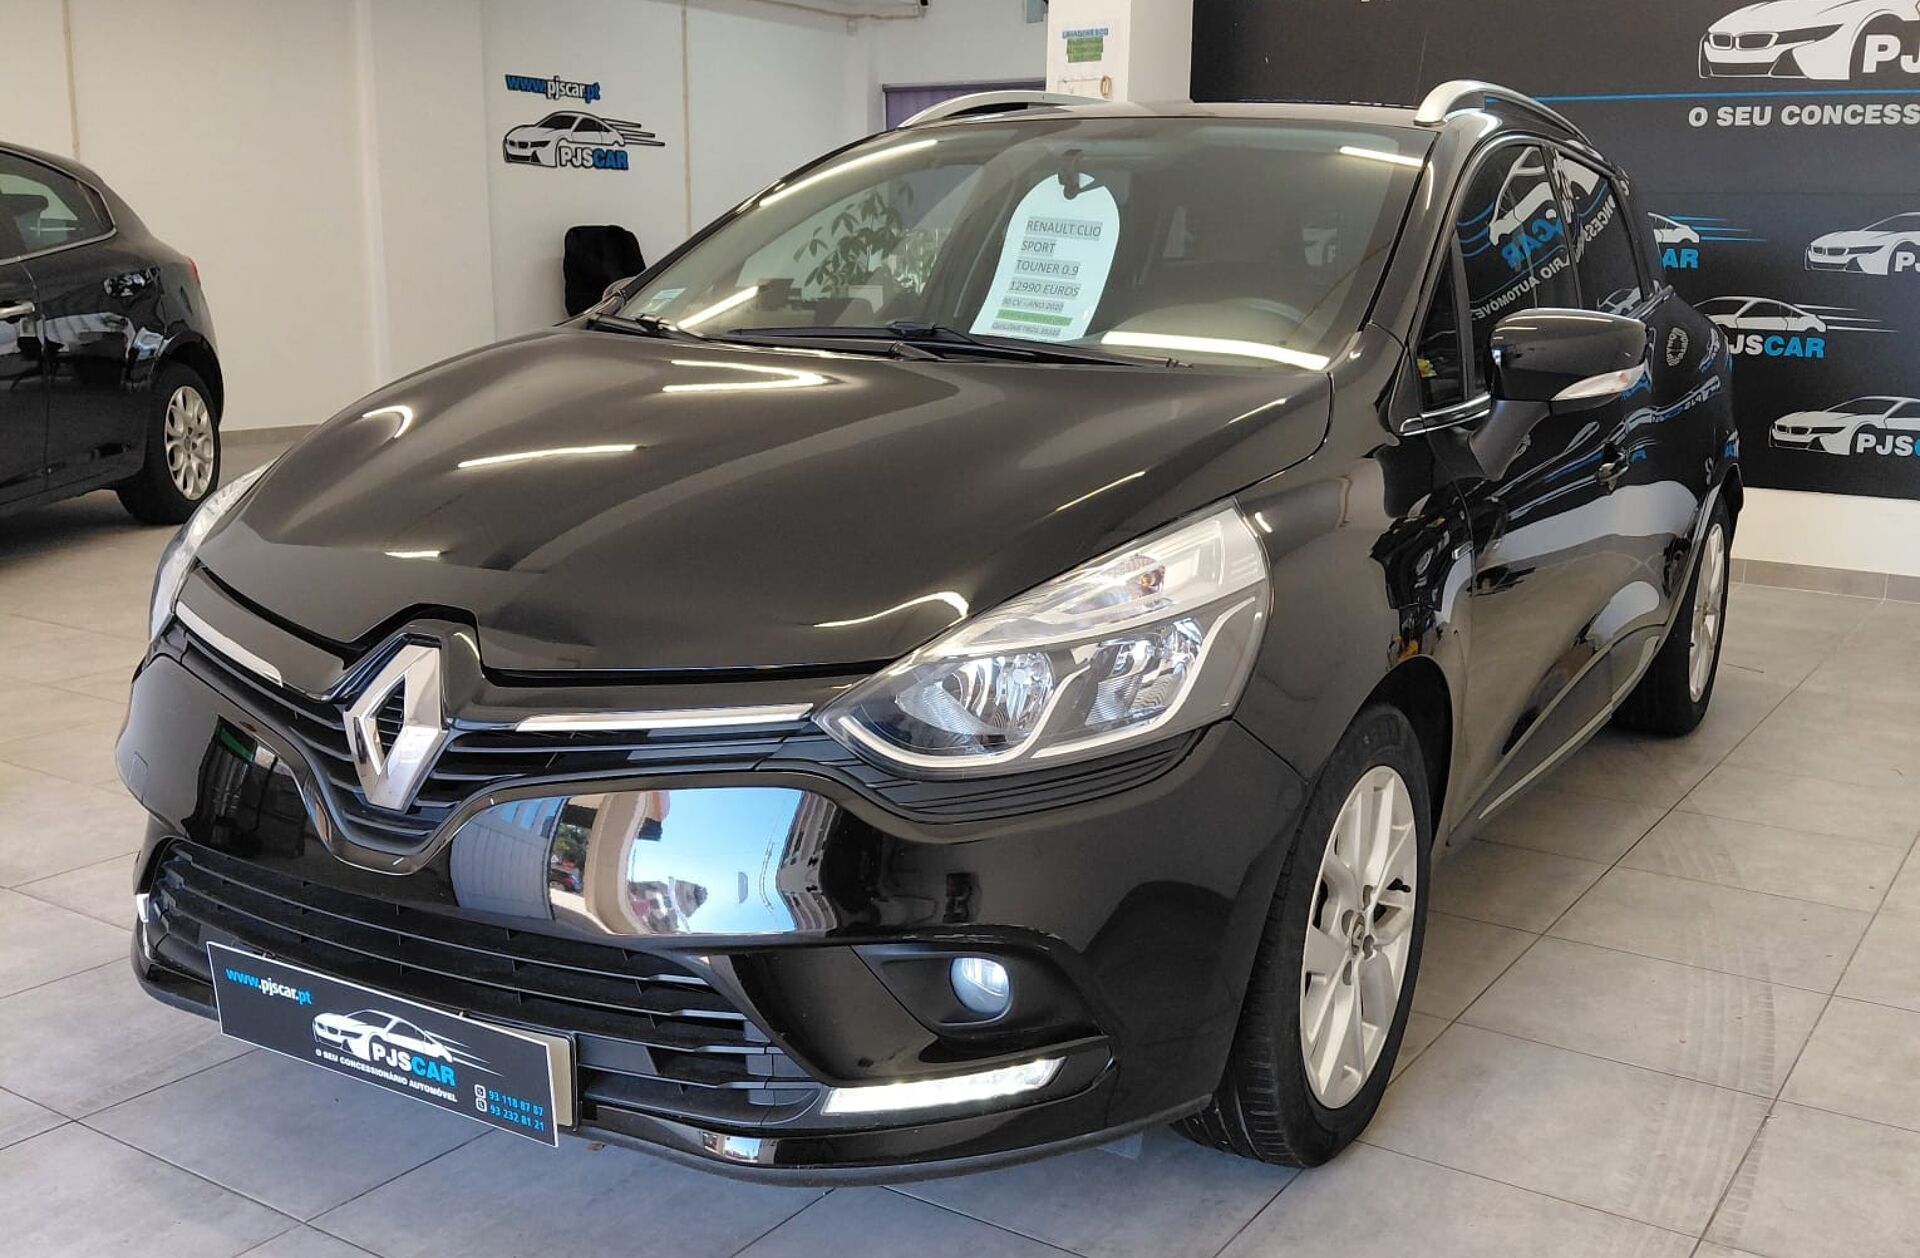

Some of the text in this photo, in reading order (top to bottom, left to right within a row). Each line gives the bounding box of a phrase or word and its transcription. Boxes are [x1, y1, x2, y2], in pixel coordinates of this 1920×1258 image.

[505, 74, 600, 103] www.pjscar.pt
[1689, 104, 1920, 127] O SEU CONCESS
[559, 146, 628, 170] PJSCAR
[1026, 220, 1102, 237] RENAULT CLIO
[1021, 241, 1056, 253] SPORT
[1016, 260, 1060, 274] TOUNER
[1895, 251, 1920, 273] P
[1009, 281, 1080, 297] 12990 EUROS
[225, 968, 312, 1005] www.pjscar.pt
[315, 1049, 322, 1057] O
[323, 1051, 339, 1062] SEU
[409, 1080, 458, 1102] AUTOMÓVEL
[371, 1042, 456, 1087] PJSCAR
[488, 1089, 499, 1101] 93
